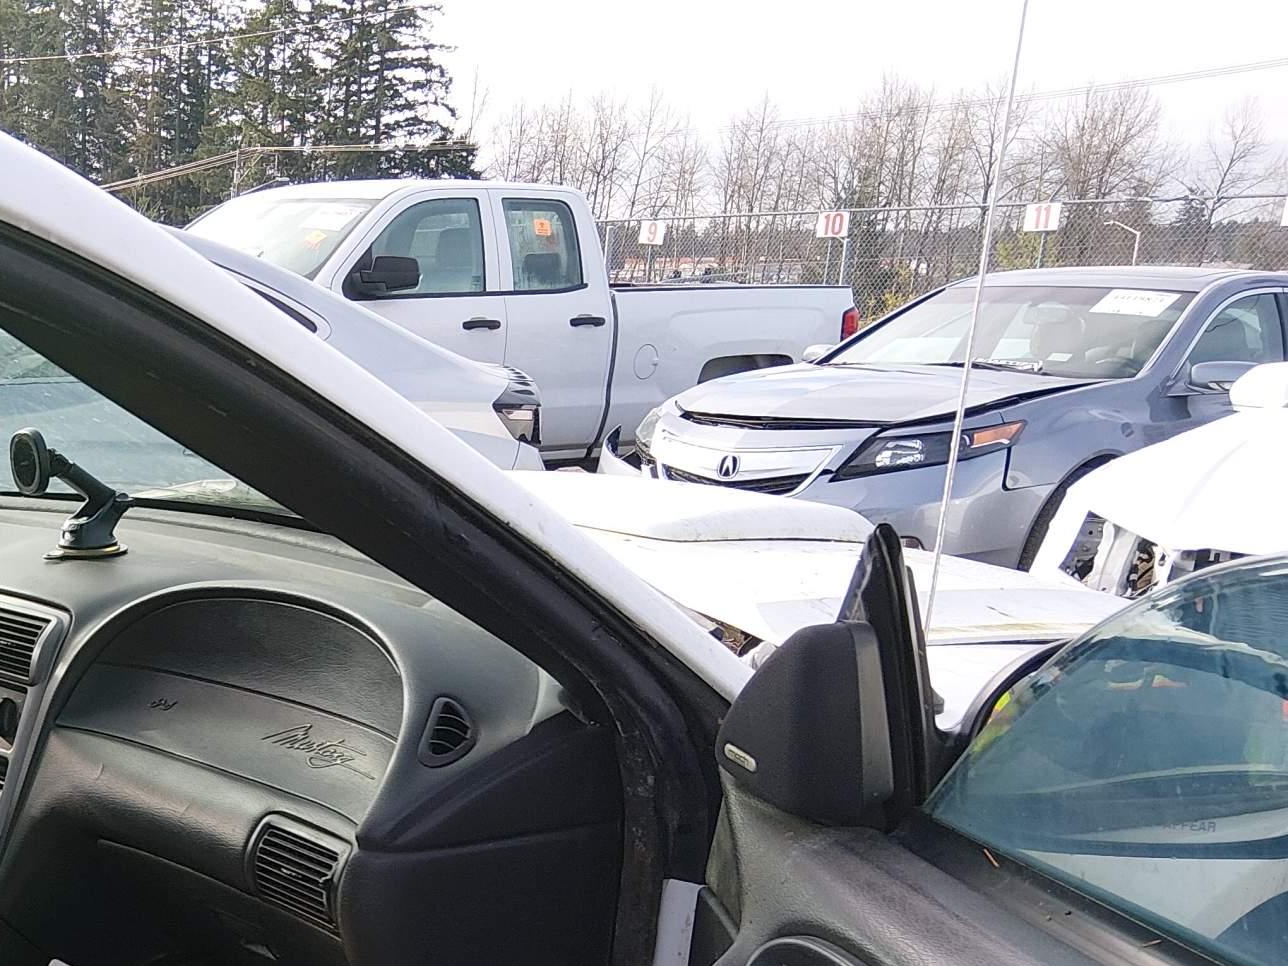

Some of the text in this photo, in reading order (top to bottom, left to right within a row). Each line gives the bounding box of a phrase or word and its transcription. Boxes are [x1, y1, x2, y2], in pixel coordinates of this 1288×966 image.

[824, 212, 844, 235] 10
[1034, 204, 1052, 229] 11
[647, 221, 658, 243] 9
[260, 723, 376, 769] Mustang
